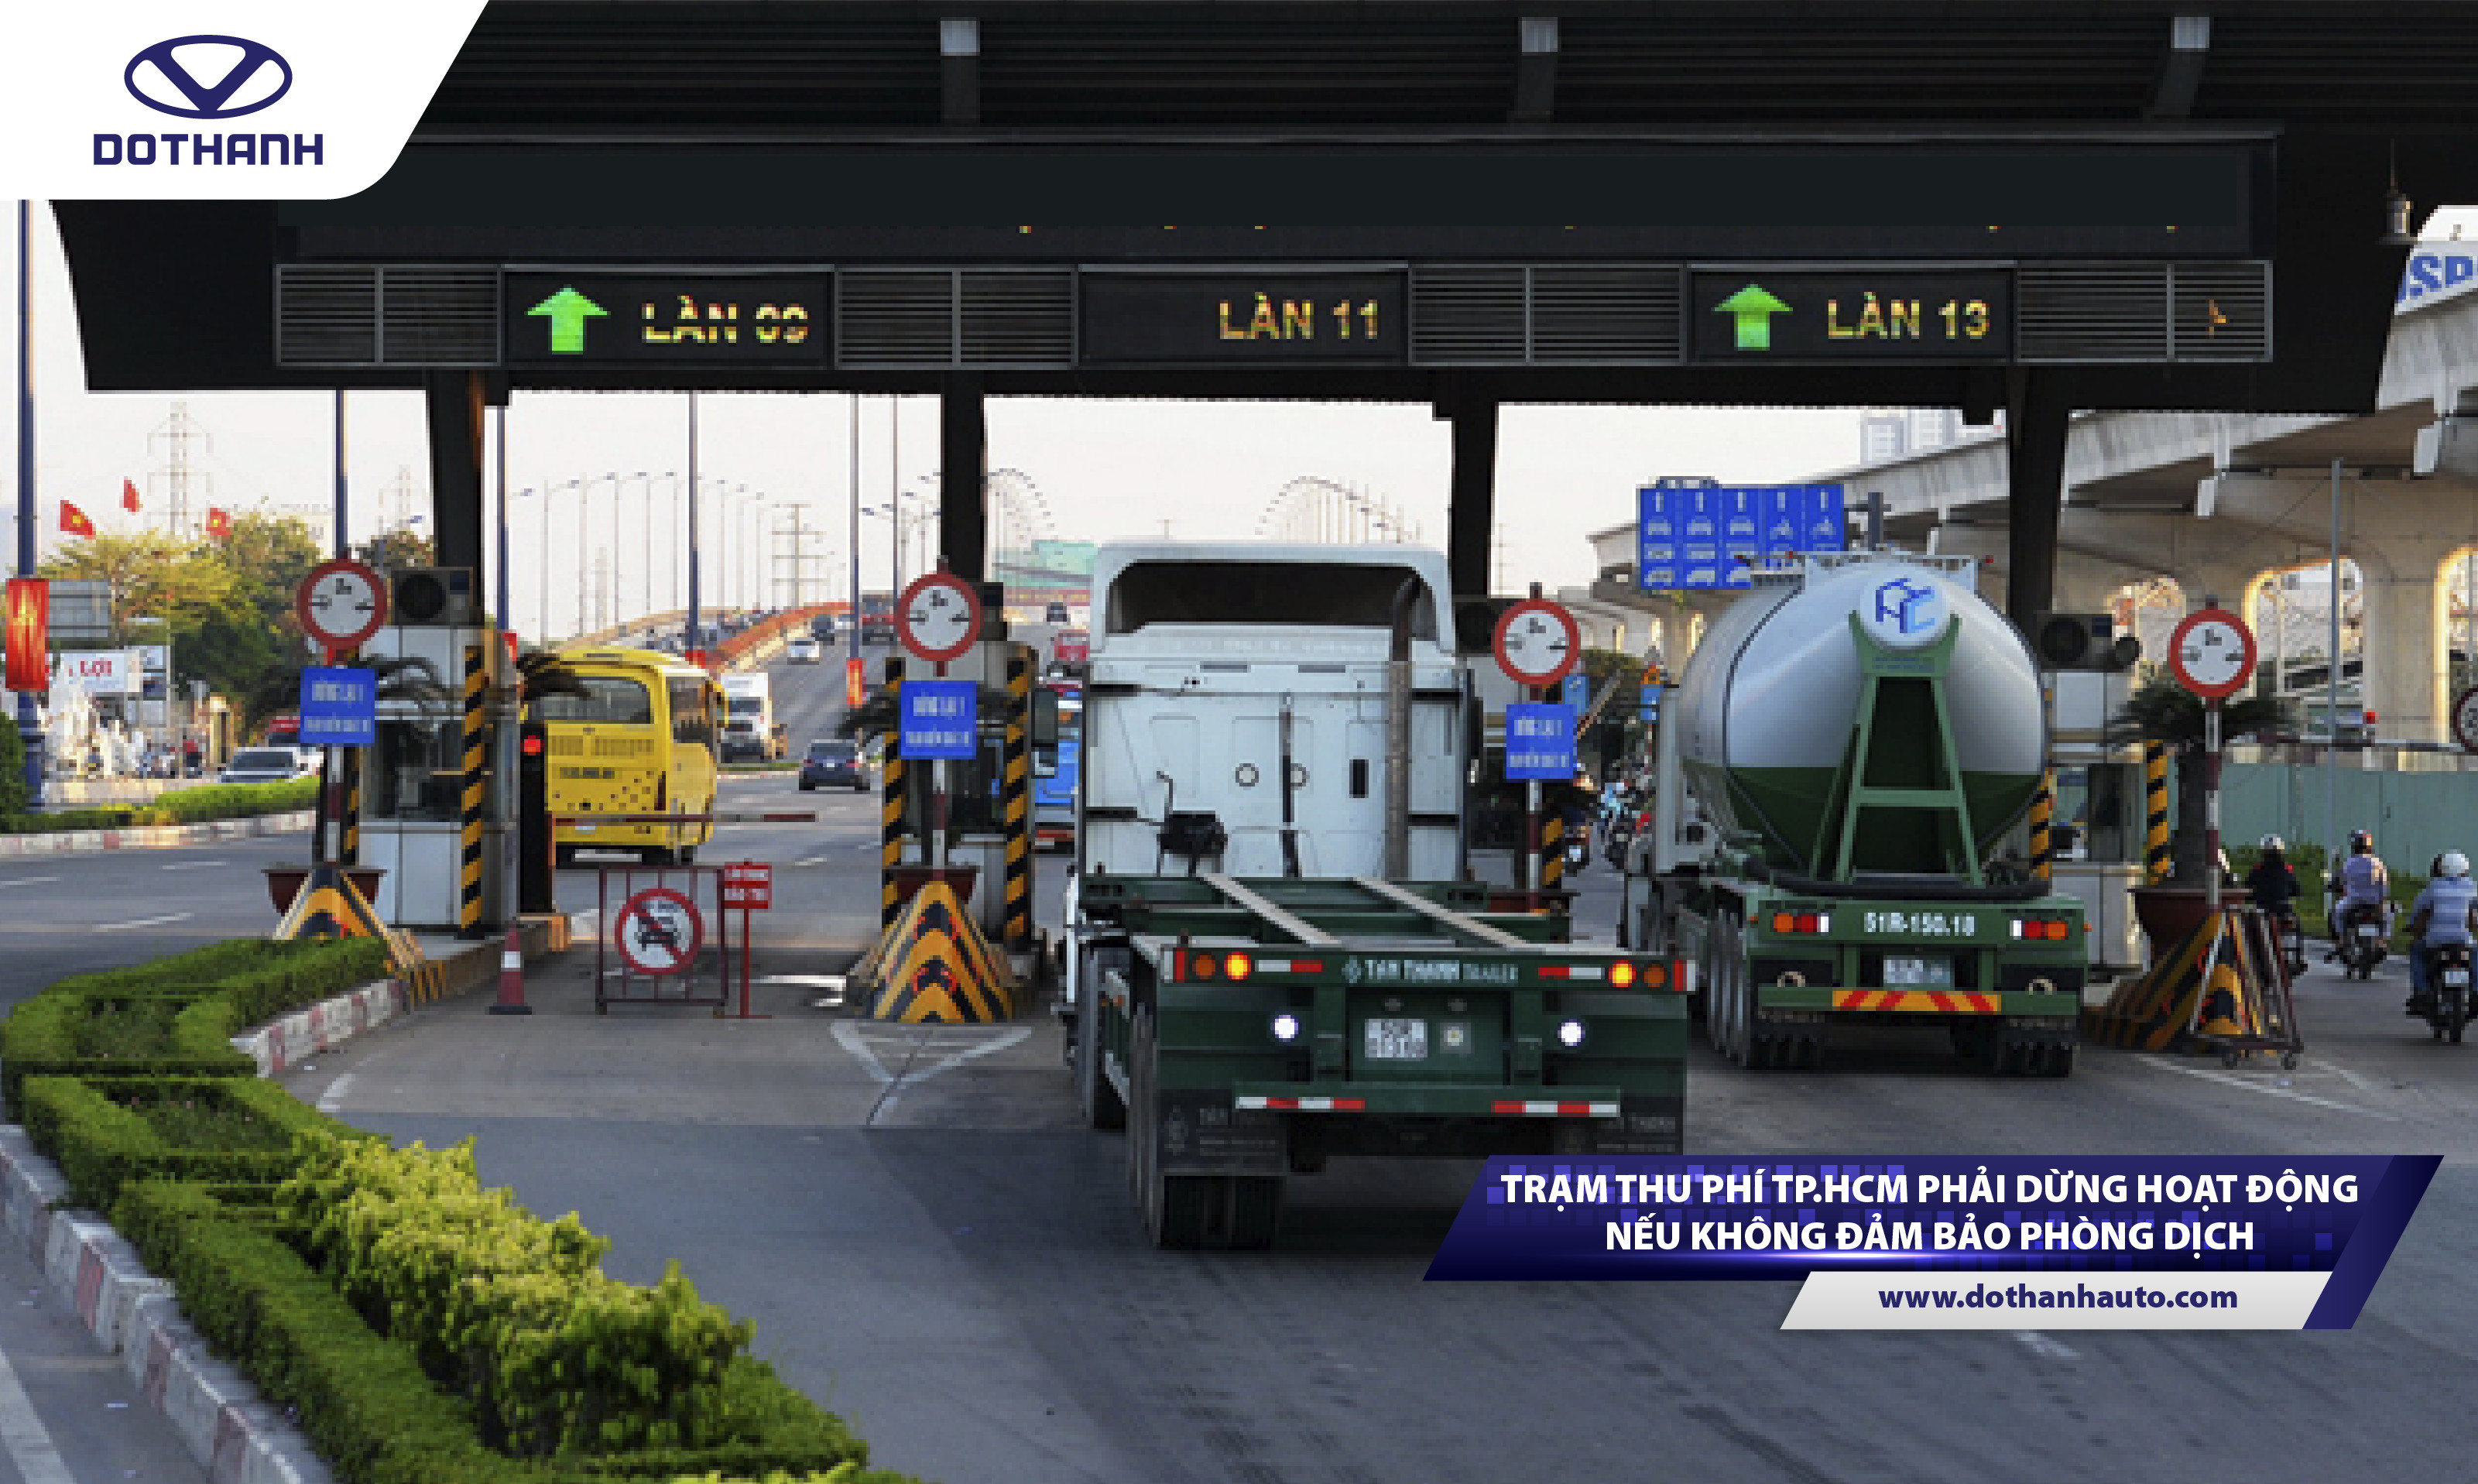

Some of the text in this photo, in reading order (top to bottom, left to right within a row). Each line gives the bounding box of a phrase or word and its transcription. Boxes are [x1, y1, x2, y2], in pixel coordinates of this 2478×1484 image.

[642, 296, 736, 343] LÀN
[1220, 292, 1378, 339] LÀN 11
[1829, 292, 1990, 339] LÀN 13
